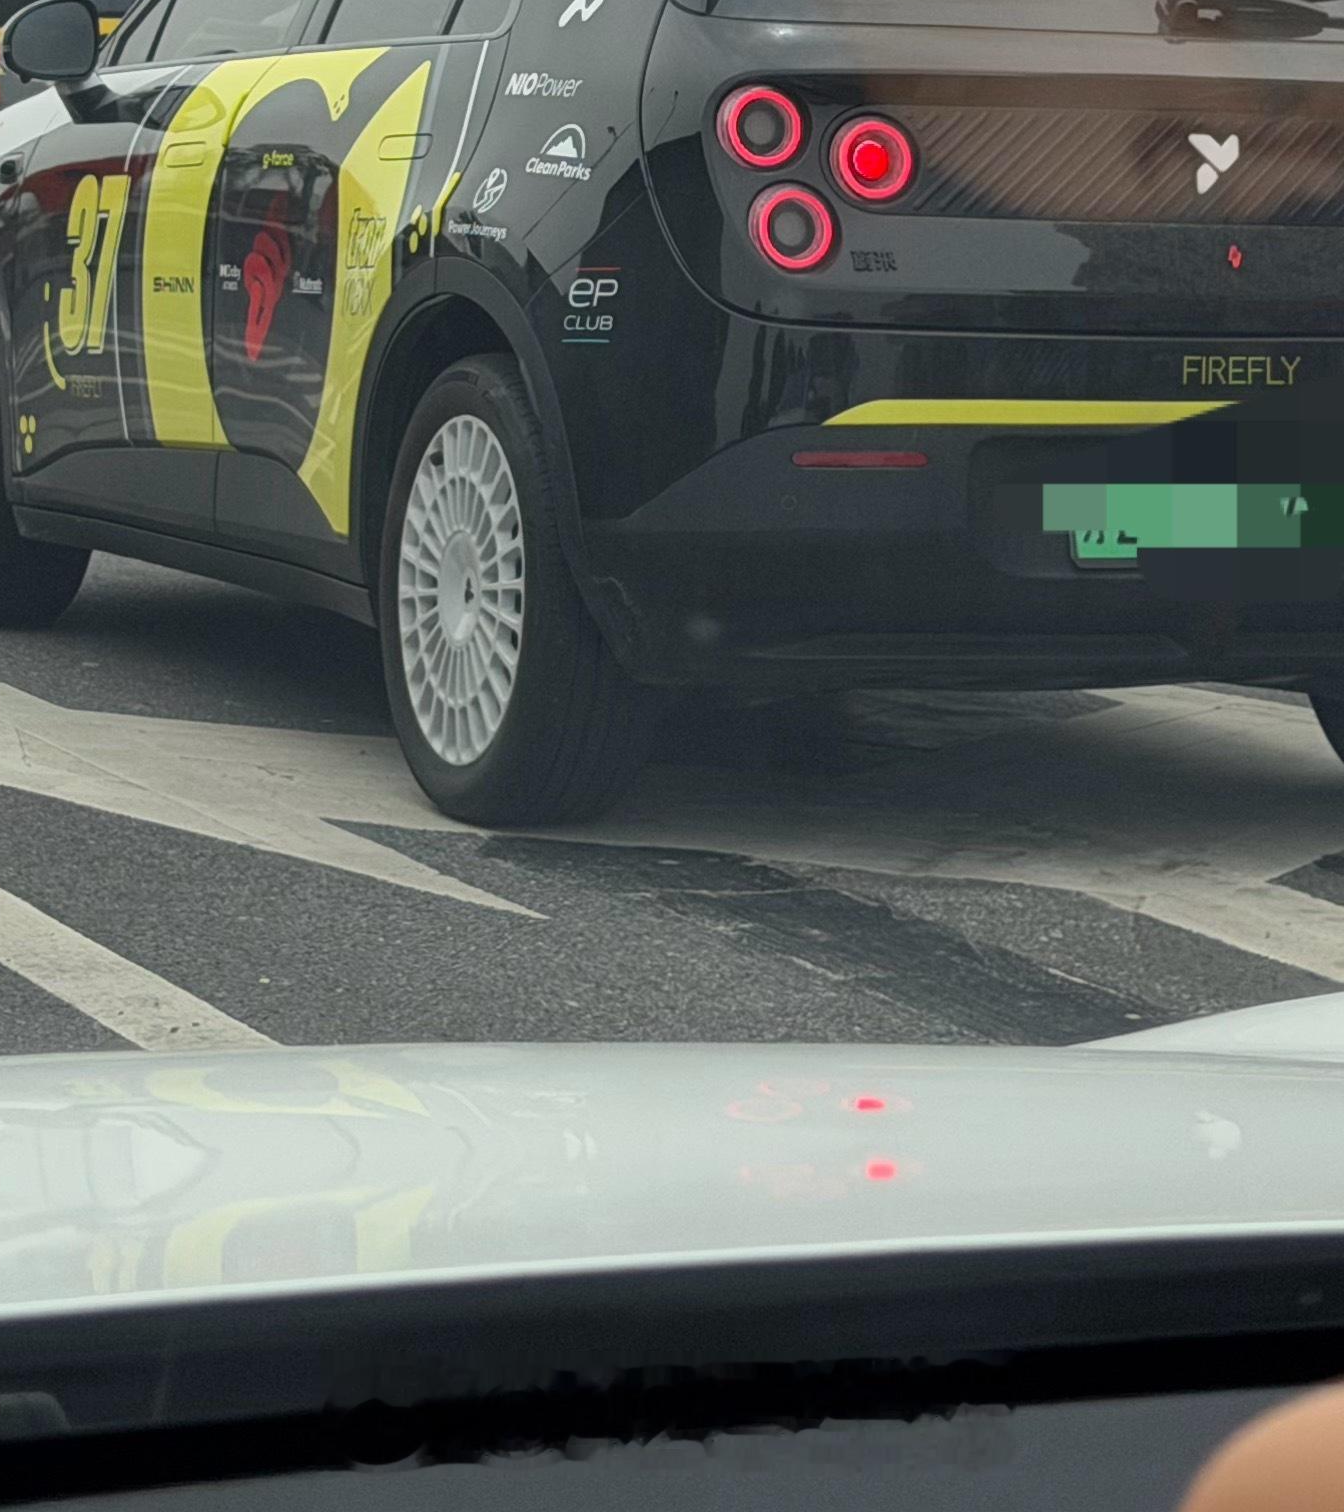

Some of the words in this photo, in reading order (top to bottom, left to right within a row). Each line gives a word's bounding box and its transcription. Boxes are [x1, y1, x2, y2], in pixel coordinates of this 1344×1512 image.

[59, 174, 132, 356] 37
[562, 314, 613, 330] CLUB
[1182, 355, 1301, 385] FIREFLY
